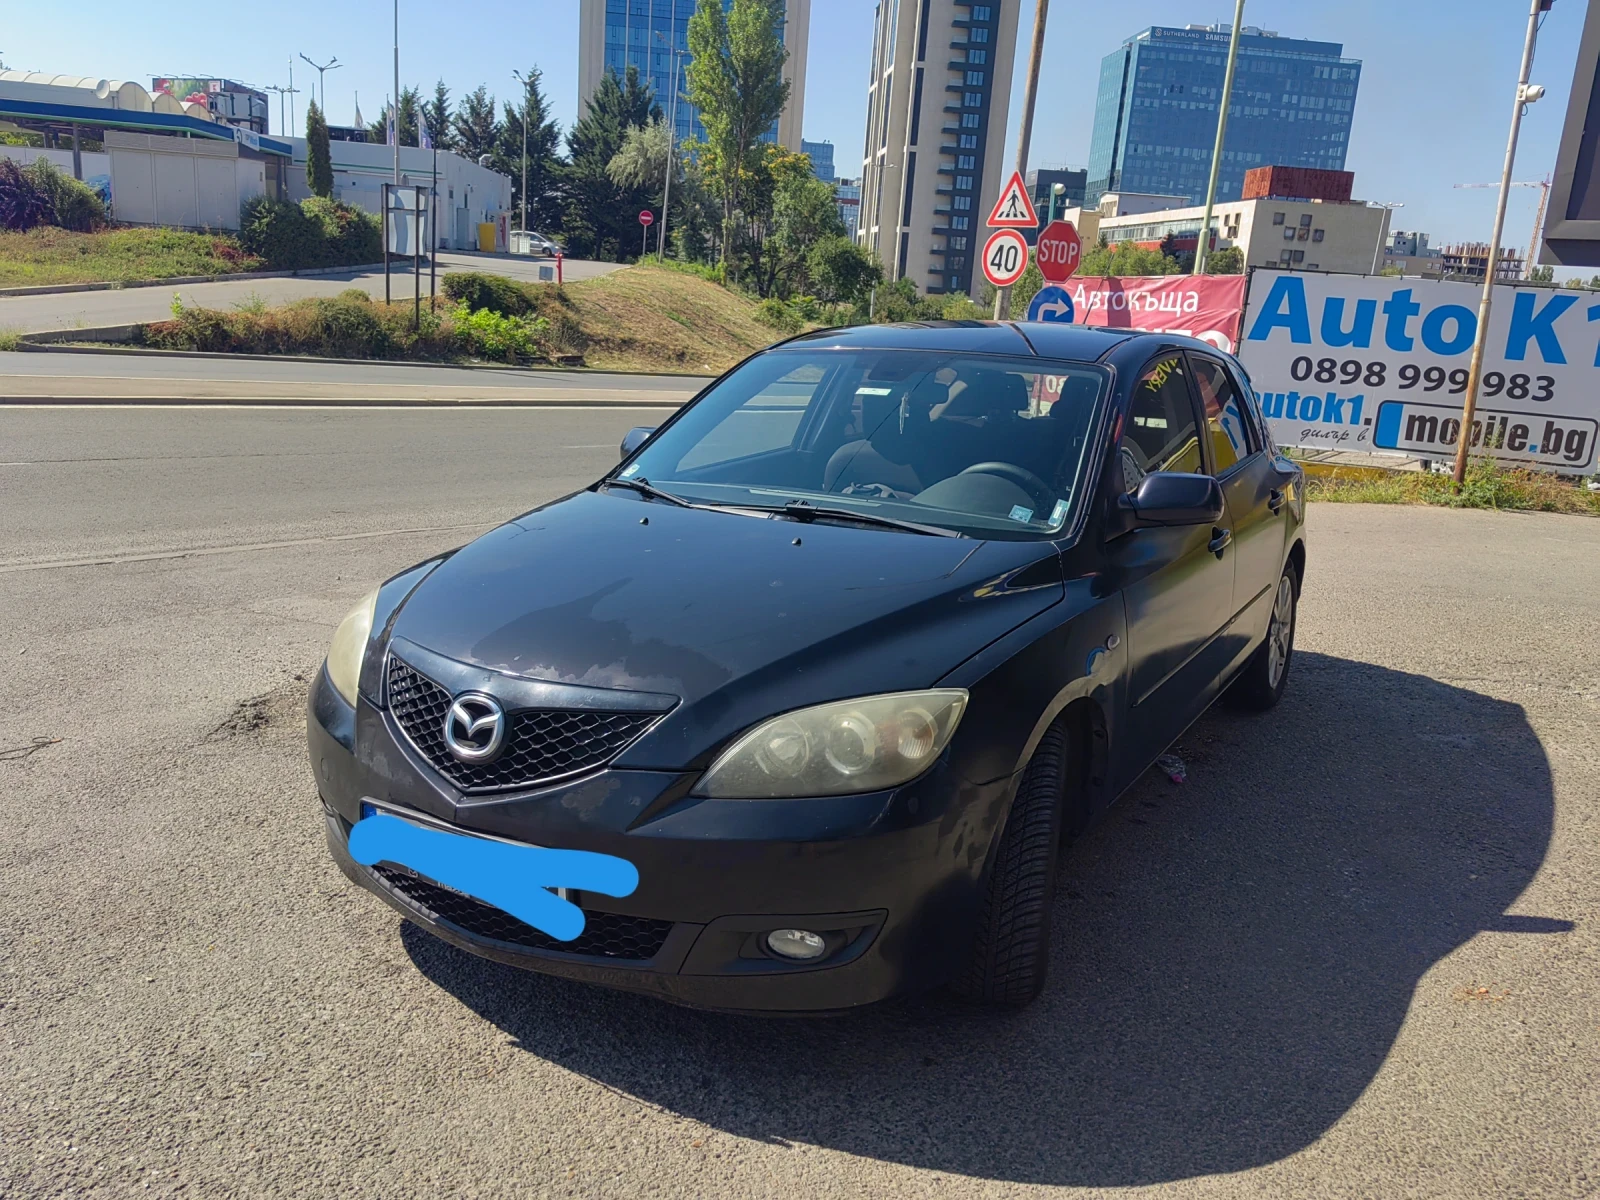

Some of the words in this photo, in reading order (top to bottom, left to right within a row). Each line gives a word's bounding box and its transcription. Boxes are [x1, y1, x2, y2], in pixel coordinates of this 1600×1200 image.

[1163, 30, 1200, 39] SUTHERLAND
[990, 244, 1019, 273] 40
[1039, 239, 1078, 265] STOP
[1072, 284, 1199, 317] Автокъща
[1247, 275, 1478, 356] Auto
[1291, 356, 1387, 387] 0898
[1398, 364, 1470, 394] 999
[1482, 371, 1556, 402] 983
[1257, 391, 1372, 427] utok1.
